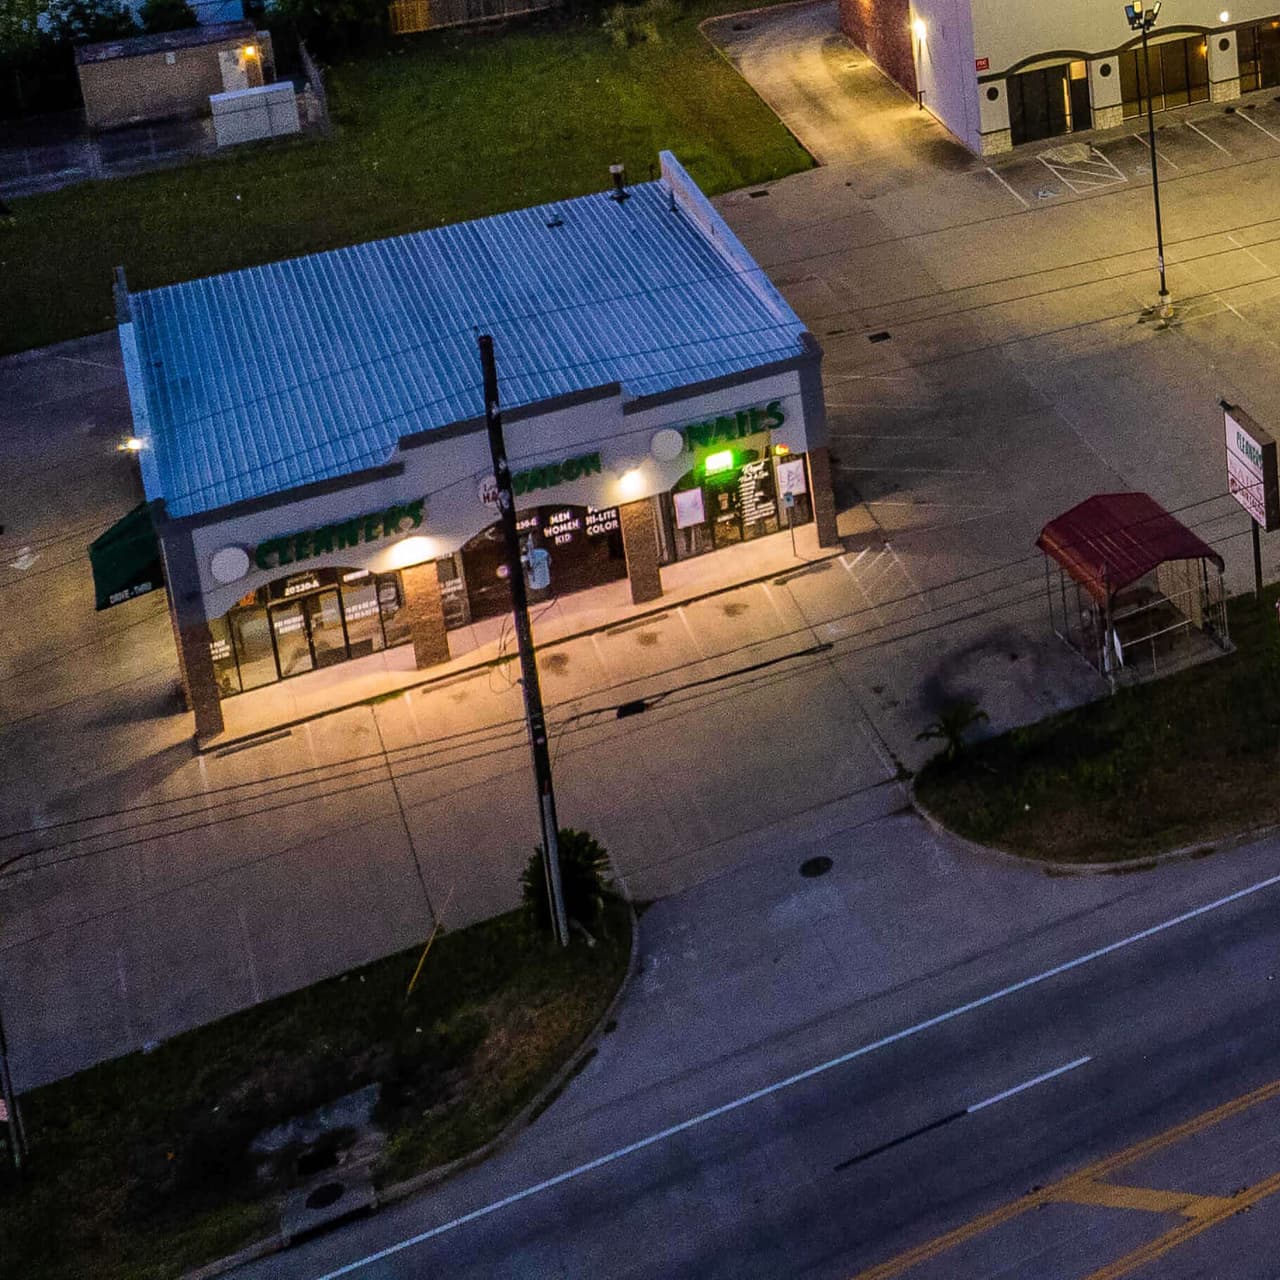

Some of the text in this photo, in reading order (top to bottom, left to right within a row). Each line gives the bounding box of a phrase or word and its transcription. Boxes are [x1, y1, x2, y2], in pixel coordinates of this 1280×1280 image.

[686, 401, 784, 451] NAILS
[550, 512, 571, 525] MEN
[585, 510, 617, 526] HI-LITE
[255, 498, 426, 570] CLEANERS
[543, 520, 580, 538] WOMEN
[586, 520, 619, 536] COLOR
